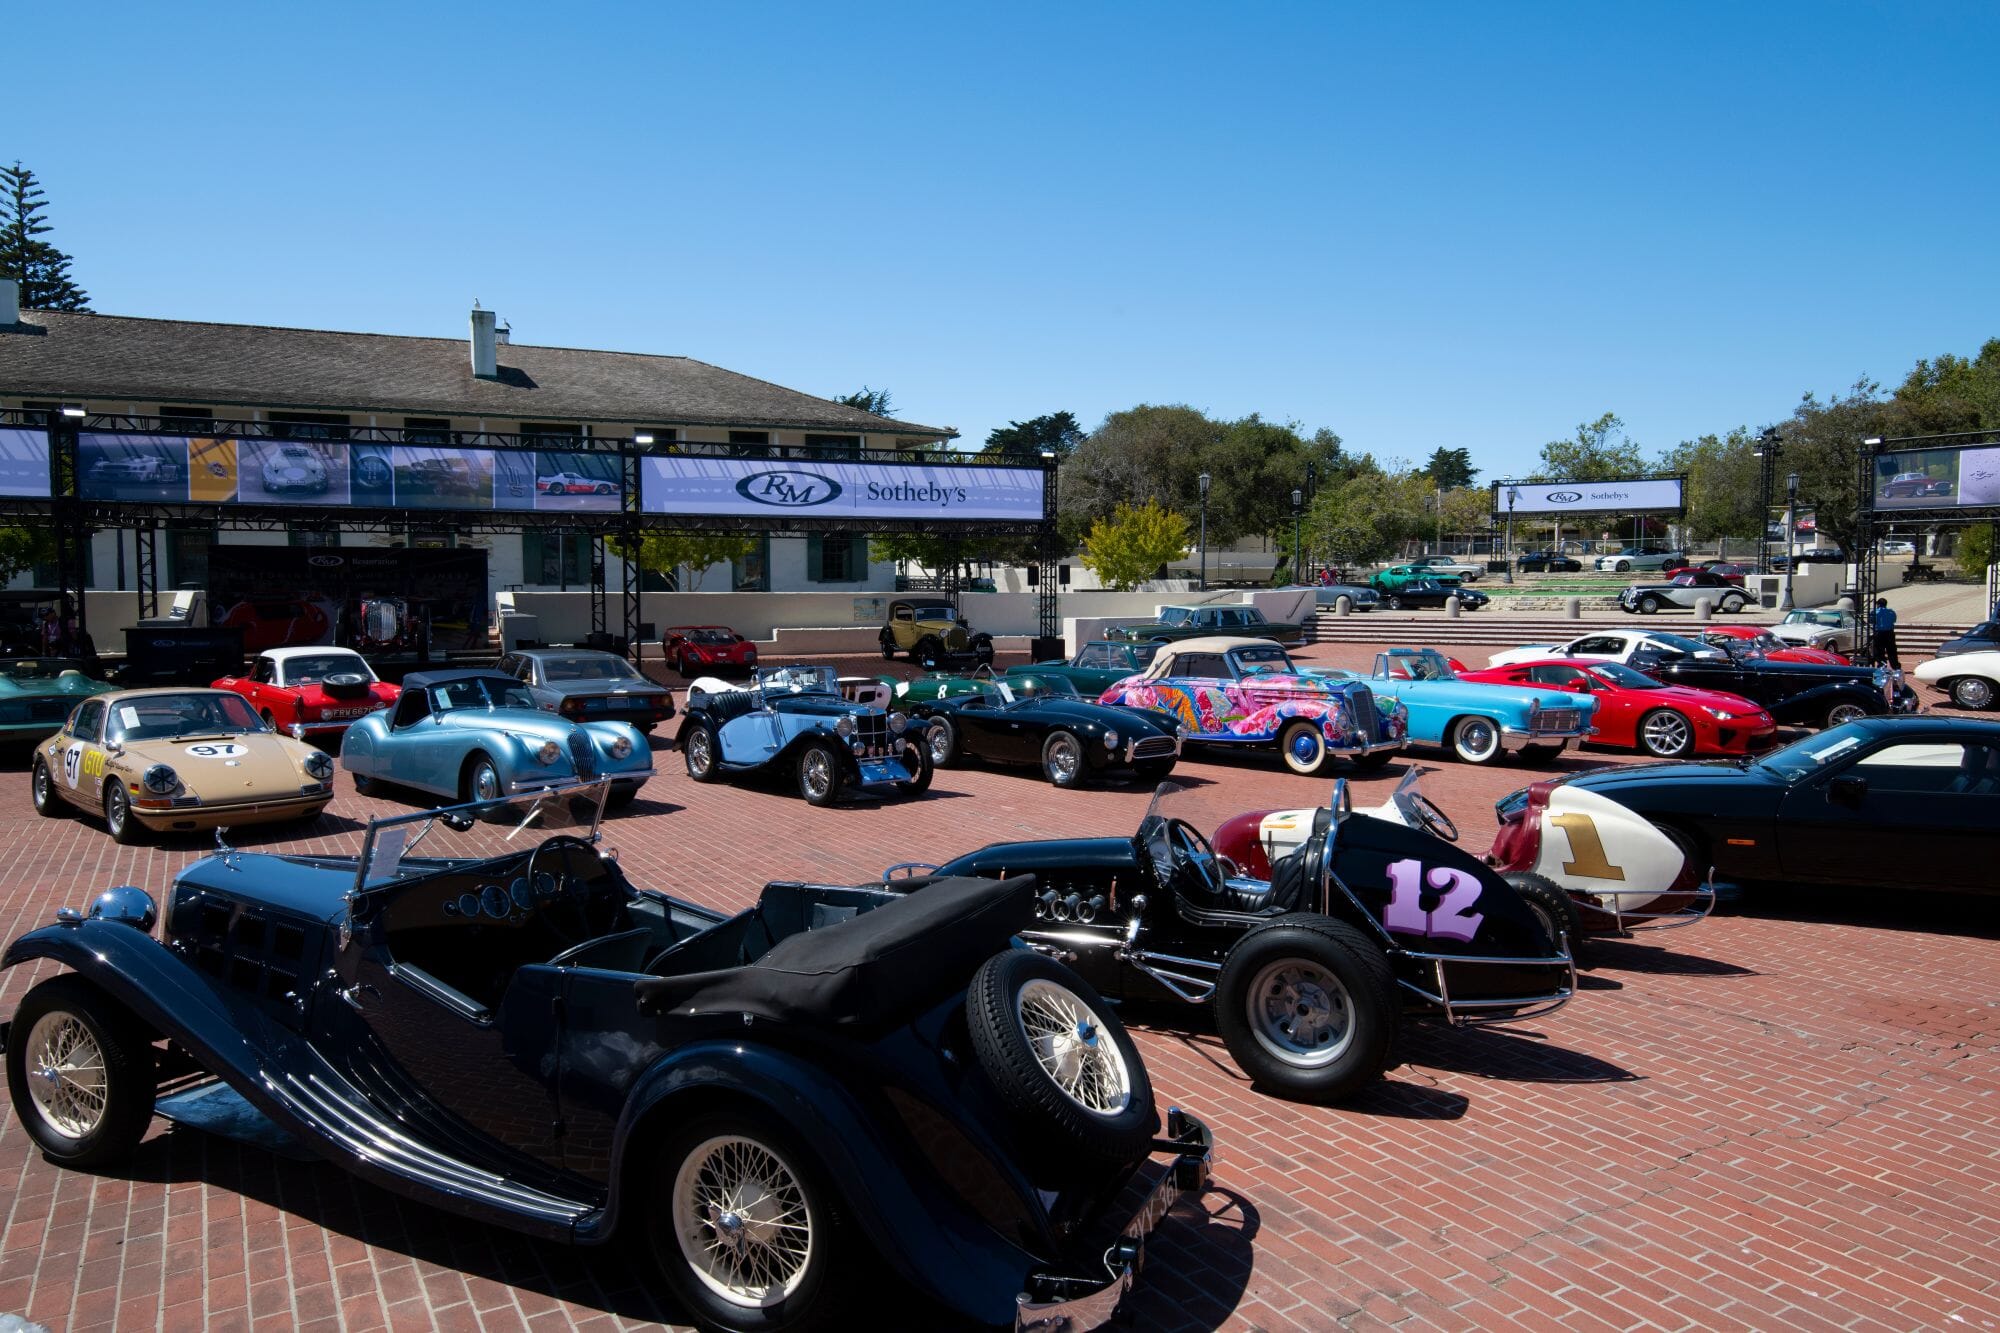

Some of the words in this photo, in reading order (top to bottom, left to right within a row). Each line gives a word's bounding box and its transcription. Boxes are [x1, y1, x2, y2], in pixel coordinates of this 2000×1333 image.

[760, 475, 815, 503] RM
[867, 480, 967, 507] Sotheby's
[1591, 492, 1629, 501] Sotheby's
[937, 684, 948, 700] 8
[66, 749, 81, 780] 97
[84, 750, 106, 778] GTU
[191, 744, 235, 756] 97
[1549, 812, 1626, 881] 1
[1383, 858, 1485, 943] 12
[1159, 1168, 1178, 1216] 361
